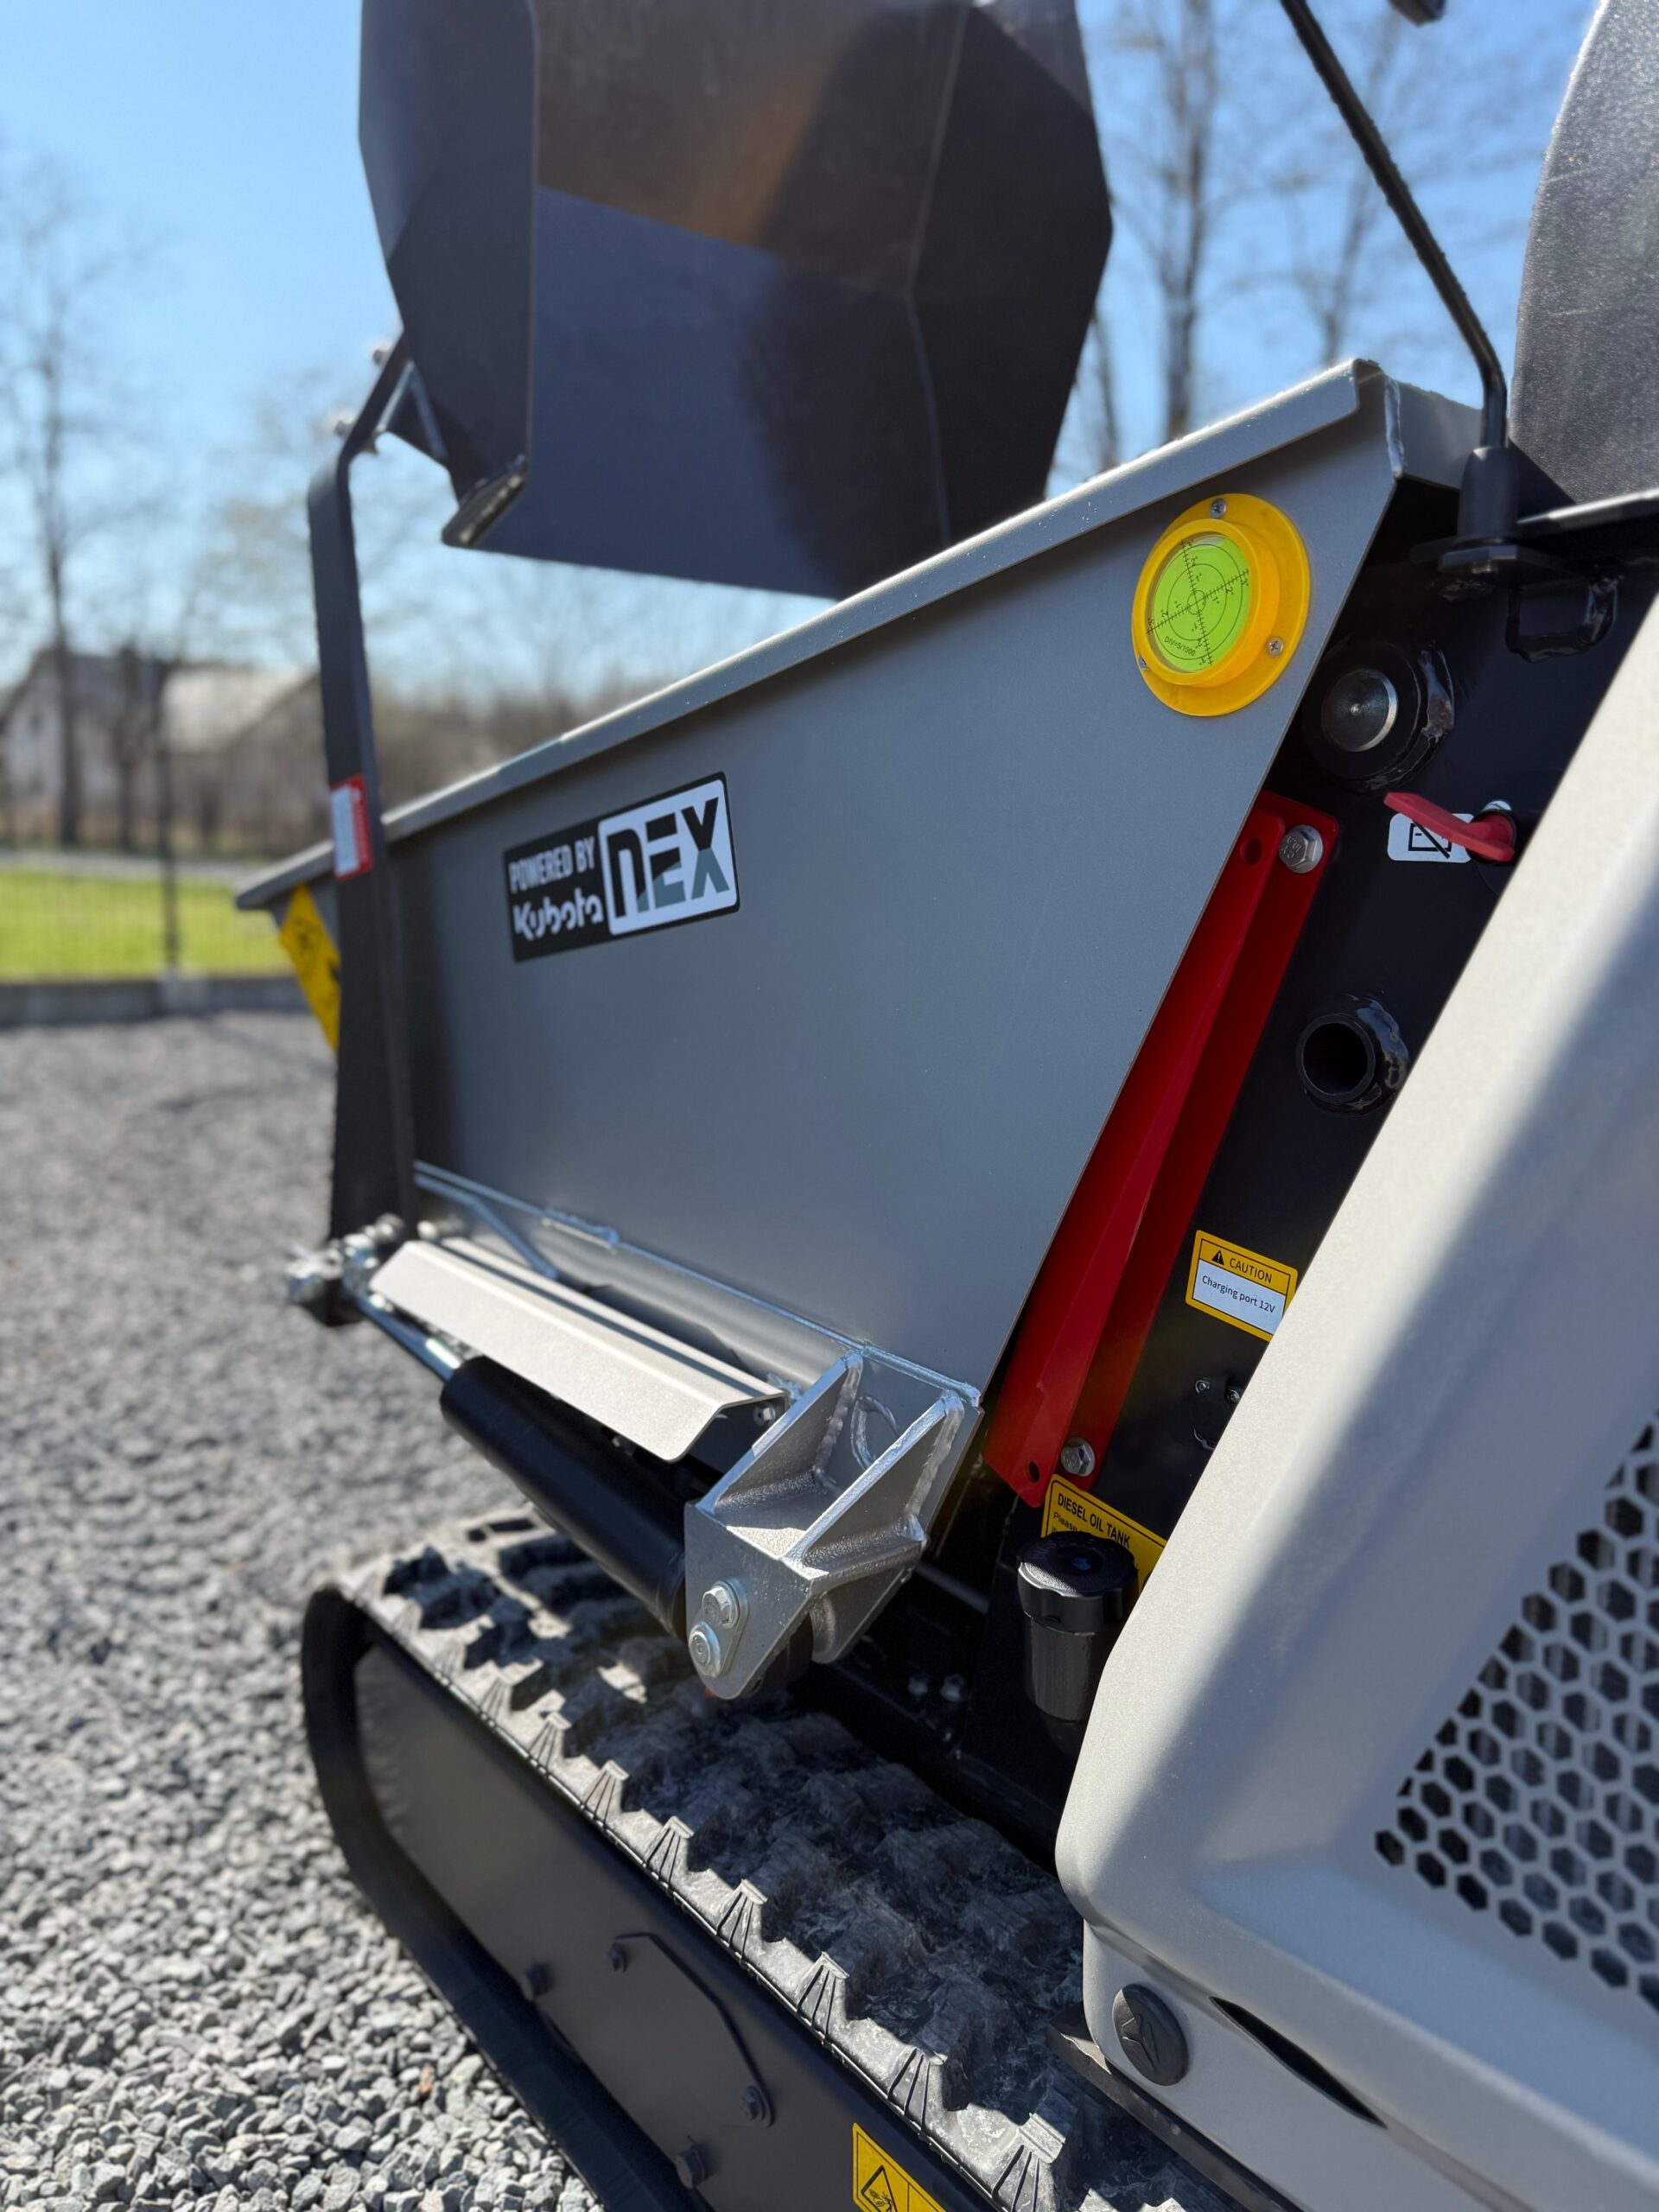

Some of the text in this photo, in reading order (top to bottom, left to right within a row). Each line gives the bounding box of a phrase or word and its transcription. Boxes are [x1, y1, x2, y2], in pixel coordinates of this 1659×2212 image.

[508, 836, 595, 893] POWERED BY
[513, 887, 604, 941] Kubota
[1202, 1275, 1275, 1313] Charging port 12V
[1229, 1258, 1273, 1284] CAUTION
[1058, 1492, 1087, 1522] DIESEL
[1090, 1513, 1103, 1533] OIL
[1107, 1522, 1131, 1549] TANK
